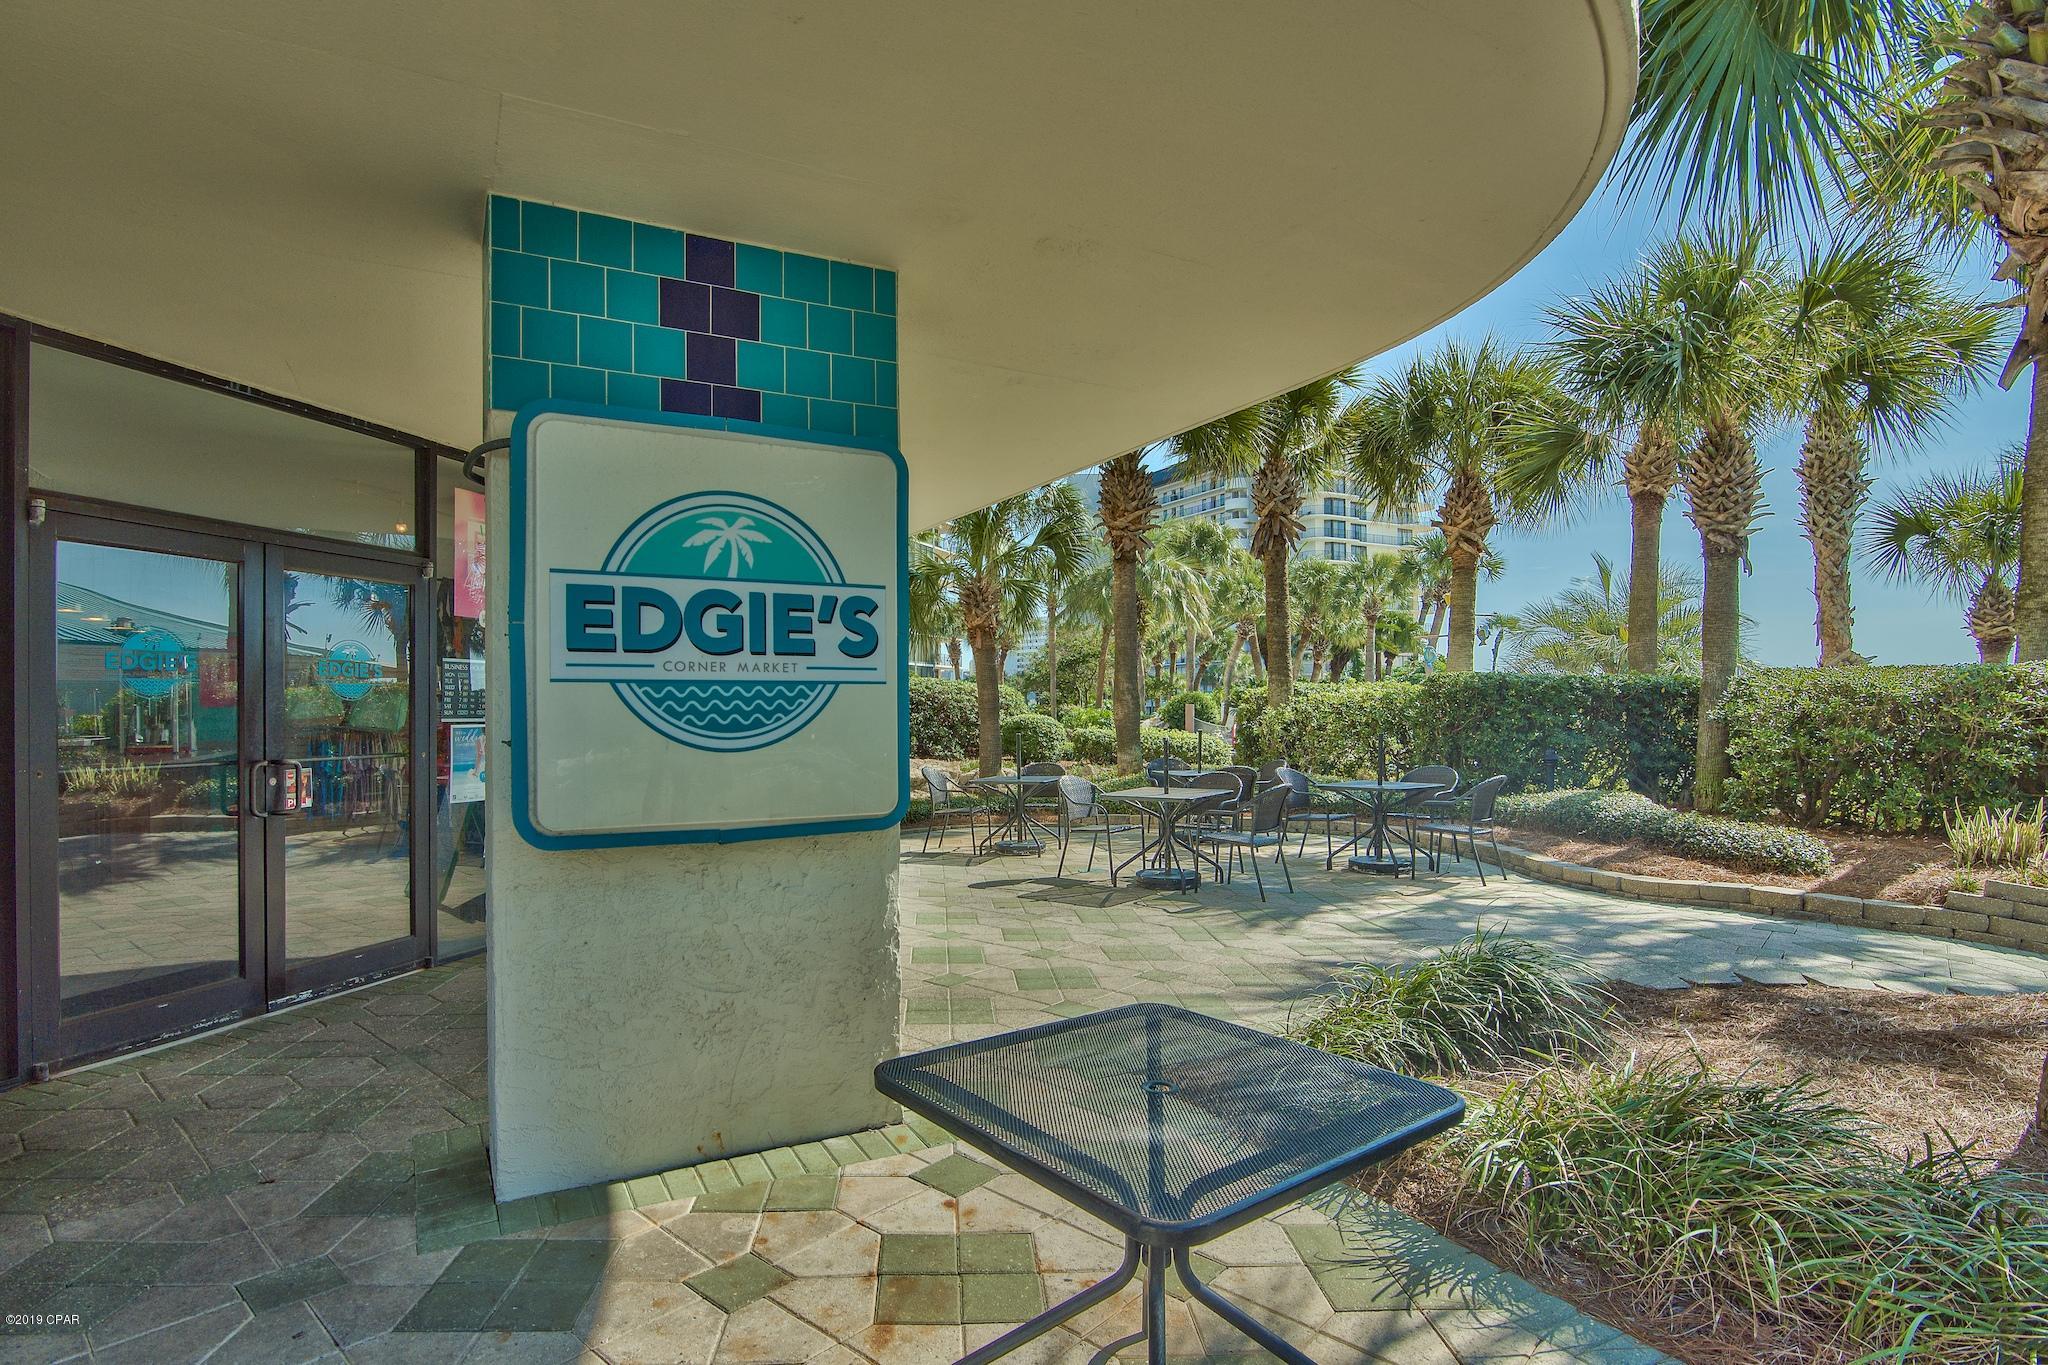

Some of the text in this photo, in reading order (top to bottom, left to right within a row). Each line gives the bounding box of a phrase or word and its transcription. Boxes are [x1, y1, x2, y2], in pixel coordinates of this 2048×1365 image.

[565, 583, 879, 659] EDGIE'S
[105, 650, 197, 672] EDGIE'S
[318, 660, 384, 678] EDGIE'S
[444, 663, 469, 671] BUSINESS
[663, 660, 800, 674] CORNER MARKET
